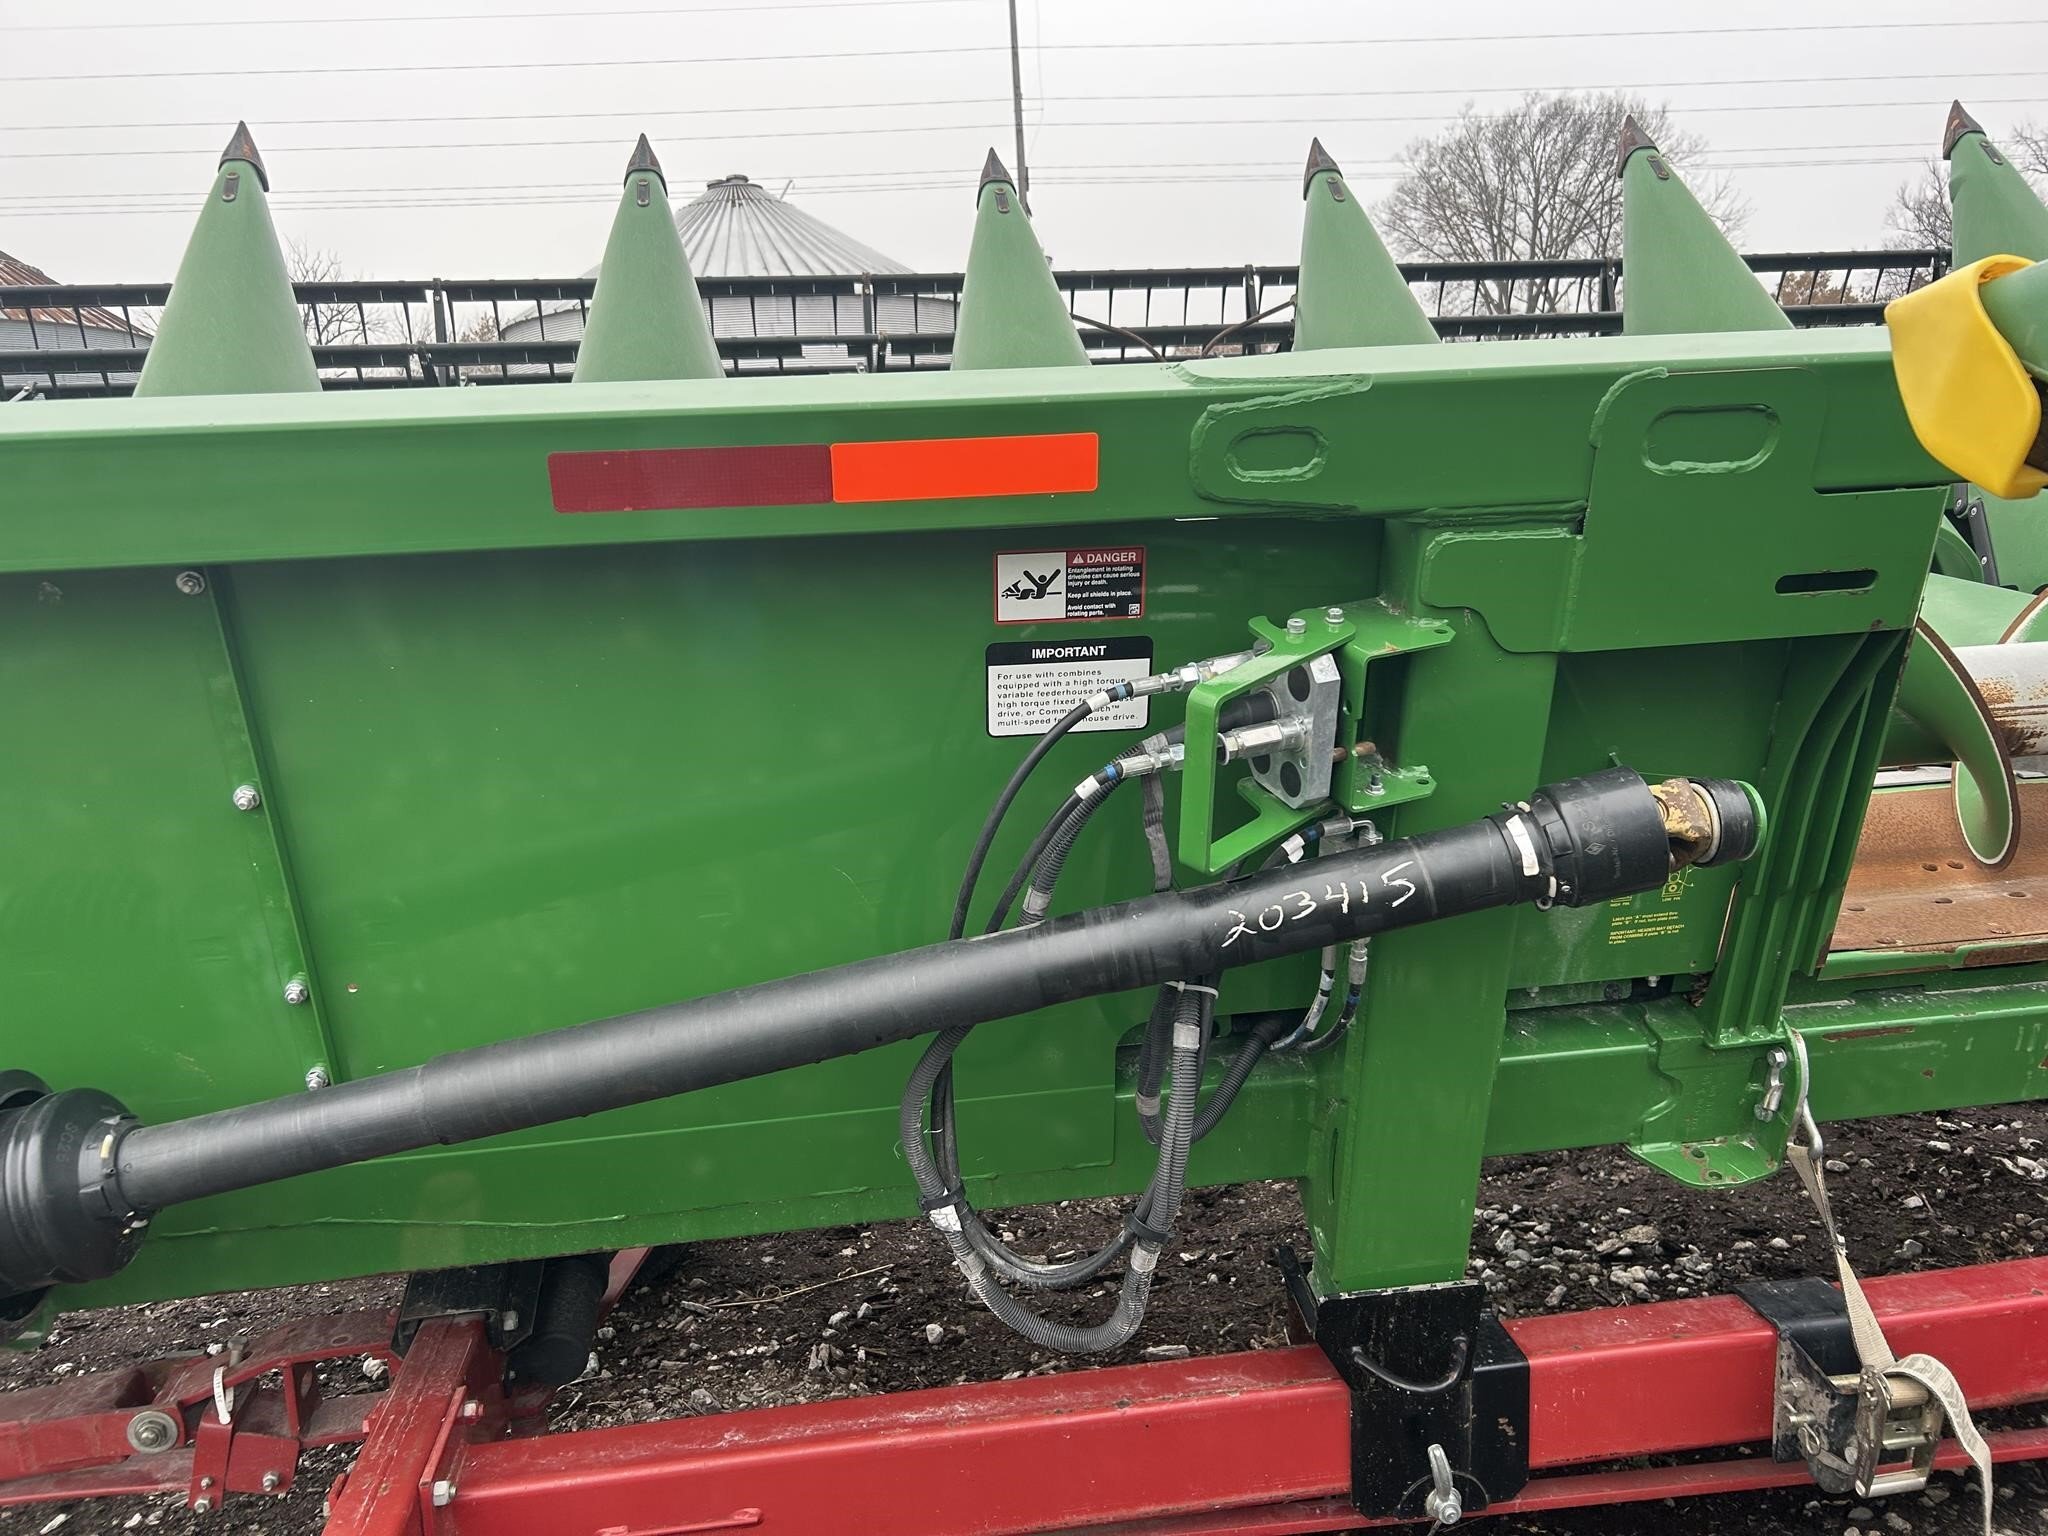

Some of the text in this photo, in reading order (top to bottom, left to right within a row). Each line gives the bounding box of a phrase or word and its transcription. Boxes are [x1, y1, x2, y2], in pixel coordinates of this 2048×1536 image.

[1087, 552, 1137, 563] DANGER
[1031, 645, 1107, 660] IMPORTANT
[1058, 669, 1102, 678] combines
[997, 681, 1040, 690] equipped
[1073, 679, 1093, 687] high
[1096, 677, 1126, 686] torque
[997, 691, 1034, 699] variable
[1037, 687, 1093, 697] feederhouse
[997, 701, 1017, 709] high
[1020, 700, 1050, 708] torque
[1053, 697, 1077, 705] fixed
[997, 710, 1023, 718] drive,
[997, 717, 1051, 727] multi-speed
[1112, 713, 1138, 721] drive.
[1220, 860, 1417, 949] 203415
